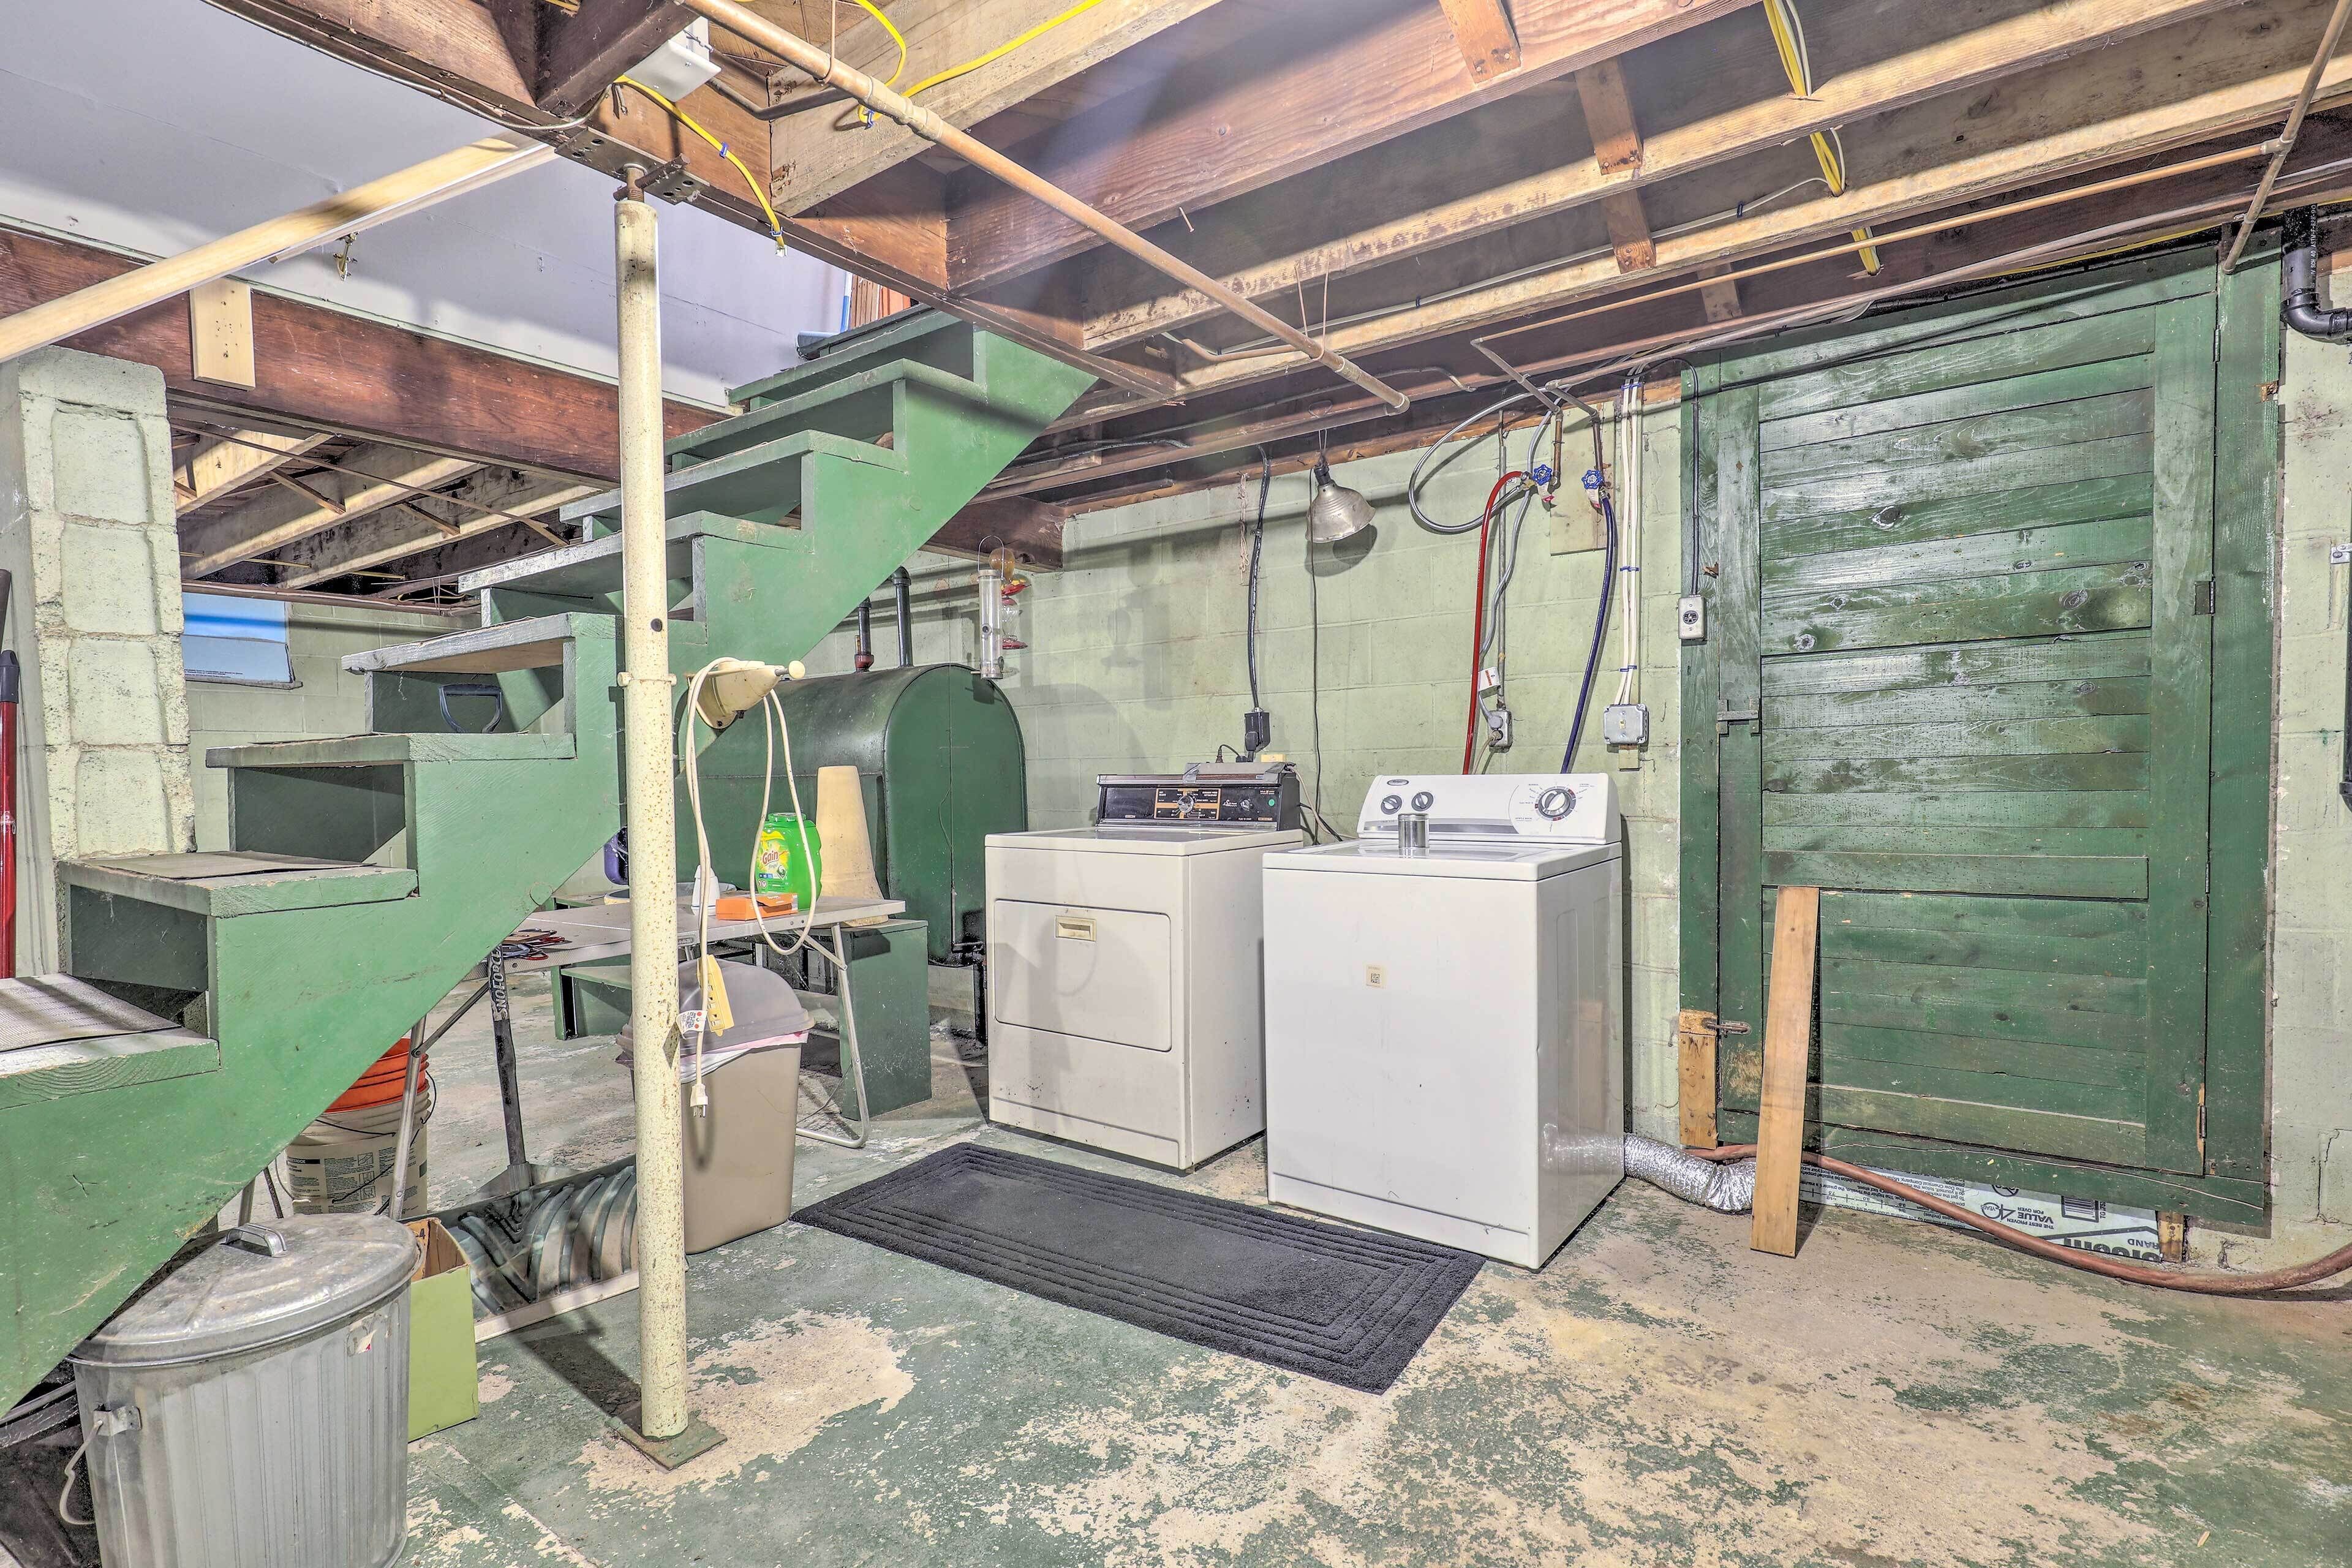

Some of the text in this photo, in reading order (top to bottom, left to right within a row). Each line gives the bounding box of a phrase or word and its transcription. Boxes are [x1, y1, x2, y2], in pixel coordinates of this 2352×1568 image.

[763, 850, 778, 865] Gain
[2018, 1212, 2054, 1224] VALUE
[2127, 1238, 2160, 1250] RAND
